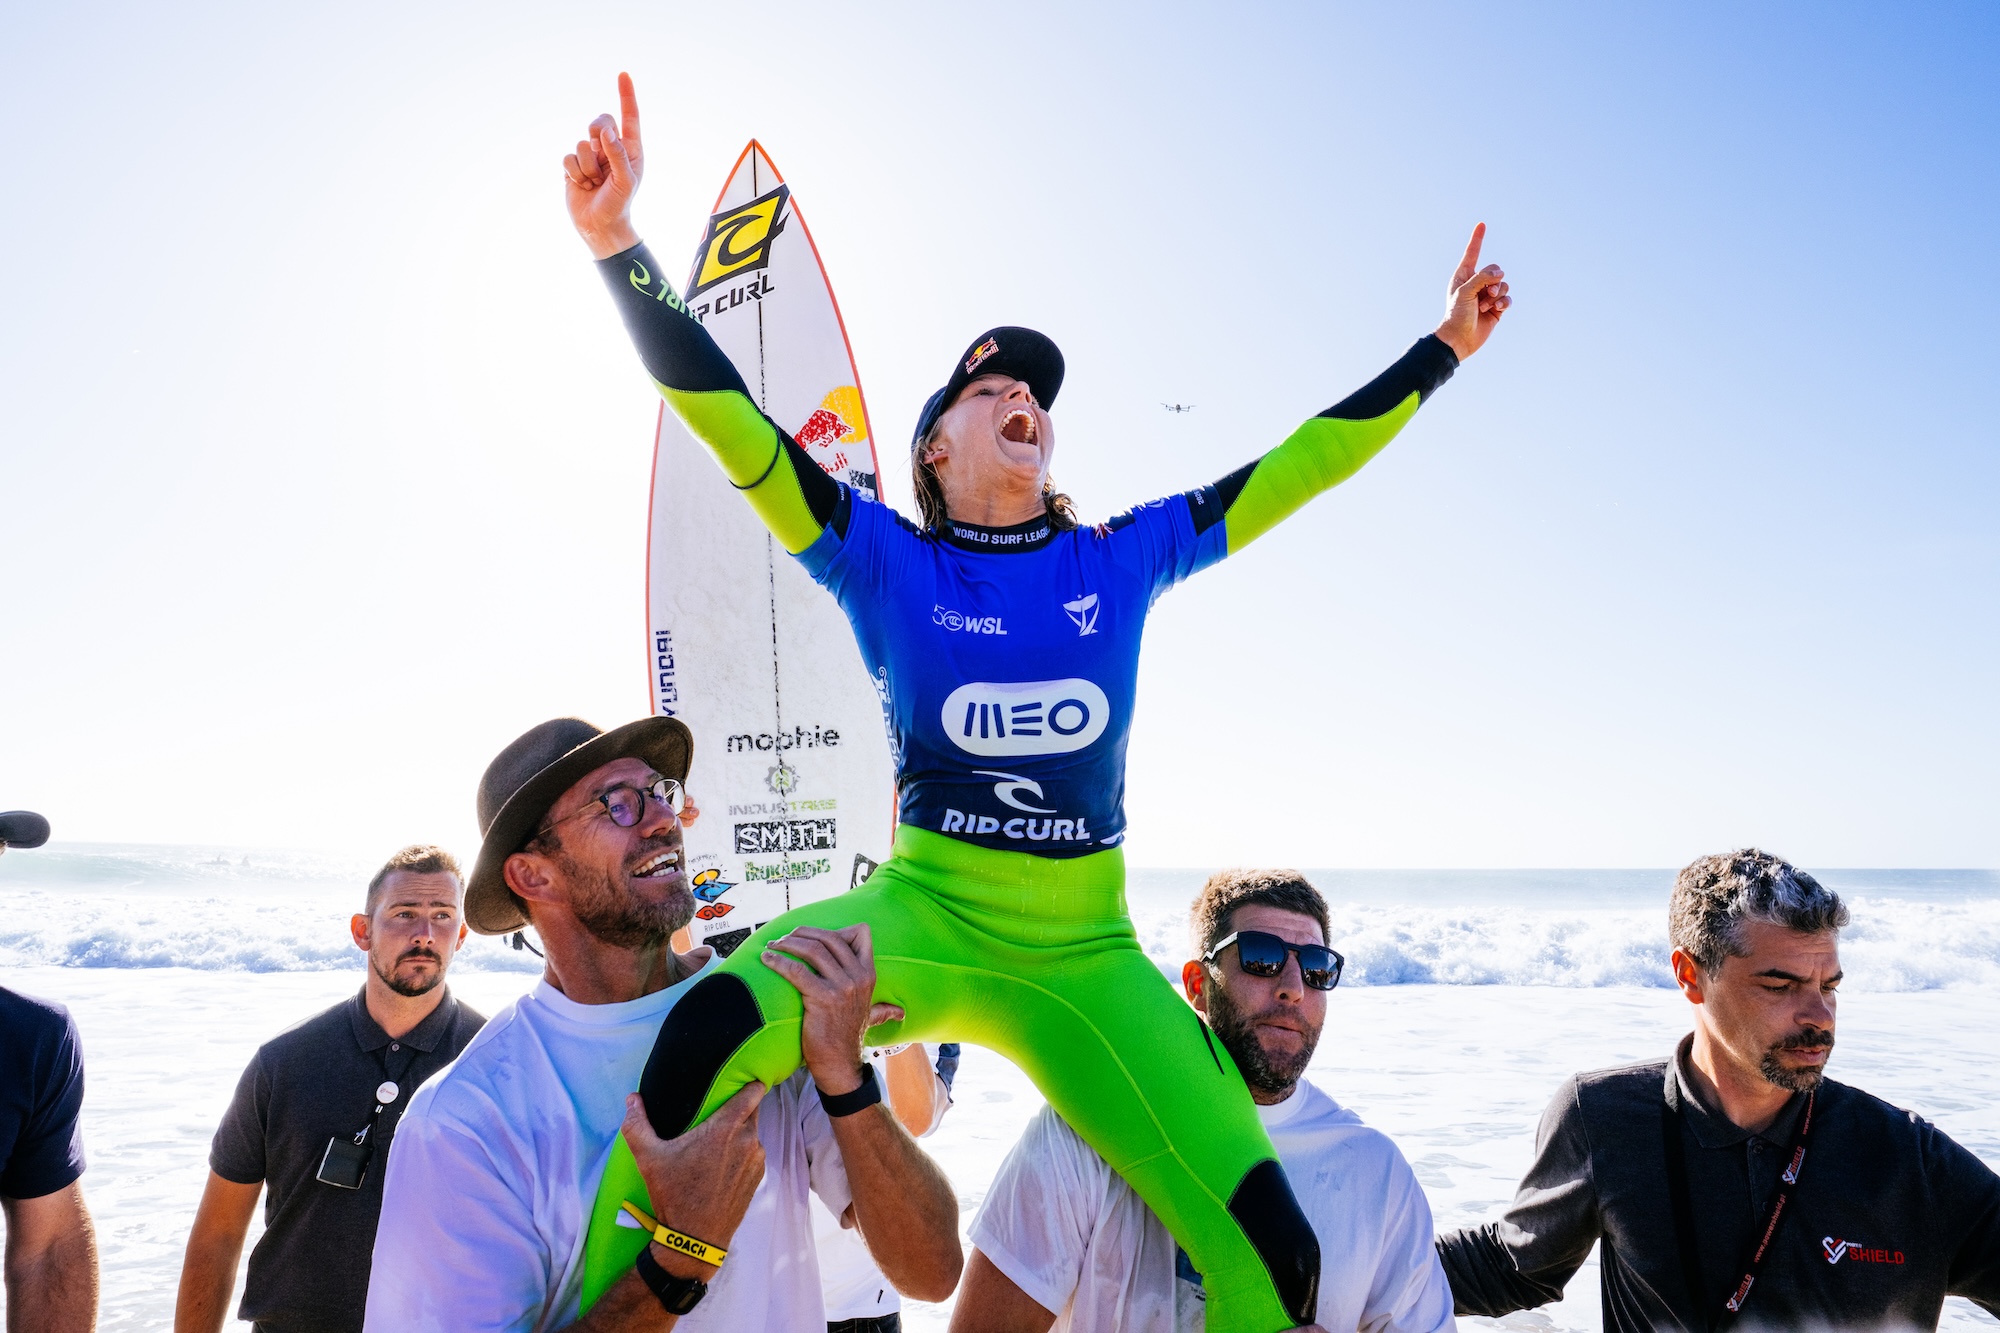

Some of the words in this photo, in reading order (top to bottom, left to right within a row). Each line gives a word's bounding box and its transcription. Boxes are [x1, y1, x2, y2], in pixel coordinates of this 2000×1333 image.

[715, 274, 775, 315] CURL
[953, 526, 989, 543] WORLD
[991, 534, 1024, 545] SURF
[965, 616, 1008, 635] WSL
[656, 630, 679, 717] YUNDAI
[963, 698, 1090, 739] MEO
[727, 725, 840, 757] mophie
[739, 823, 832, 850] SMITH
[941, 808, 1000, 834] RIP
[1002, 817, 1091, 841] CURL
[704, 923, 714, 932] RIP
[715, 920, 730, 931] CURL
[1790, 1146, 1803, 1174] SHIELD
[666, 1233, 707, 1258] COACH
[1849, 1247, 1905, 1265] SHIELD
[1734, 1274, 1752, 1302] SHIELD
